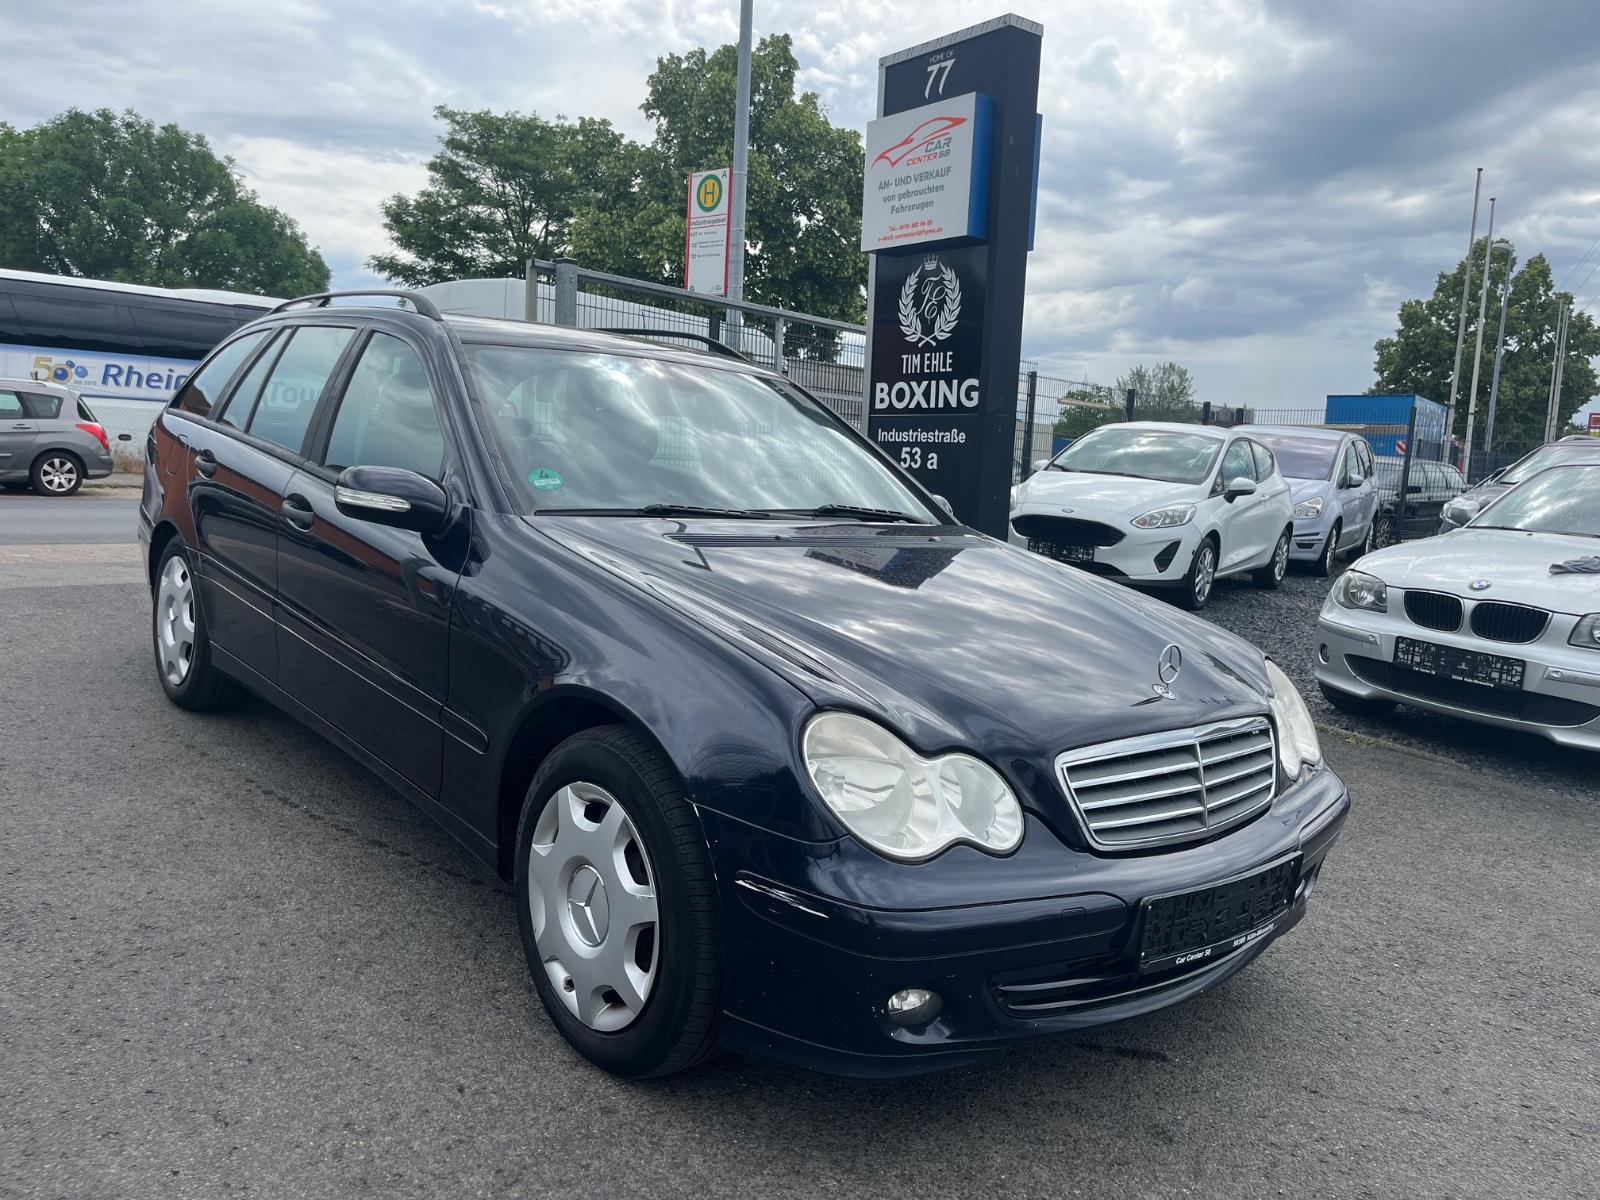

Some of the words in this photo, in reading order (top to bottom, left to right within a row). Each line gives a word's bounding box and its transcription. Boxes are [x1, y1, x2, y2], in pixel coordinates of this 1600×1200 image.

[929, 52, 946, 63] HOME
[946, 49, 955, 58] OF
[924, 58, 956, 99] 77
[925, 137, 952, 153] CAR
[906, 152, 938, 167] CENTER
[878, 180, 893, 191] AN-
[894, 175, 912, 188] UND
[913, 166, 952, 183] VERKAUF
[883, 194, 896, 203] von
[897, 184, 945, 202] gebrauchten
[890, 200, 934, 214] Fahrzeugen
[901, 353, 921, 374] TIM
[924, 351, 953, 373] EHLE
[874, 378, 980, 410] BOXING
[878, 428, 966, 443] Industriestraße
[900, 446, 921, 469] 53
[926, 452, 938, 470] a
[1175, 956, 1186, 965] Car
[1186, 951, 1204, 962] Center
